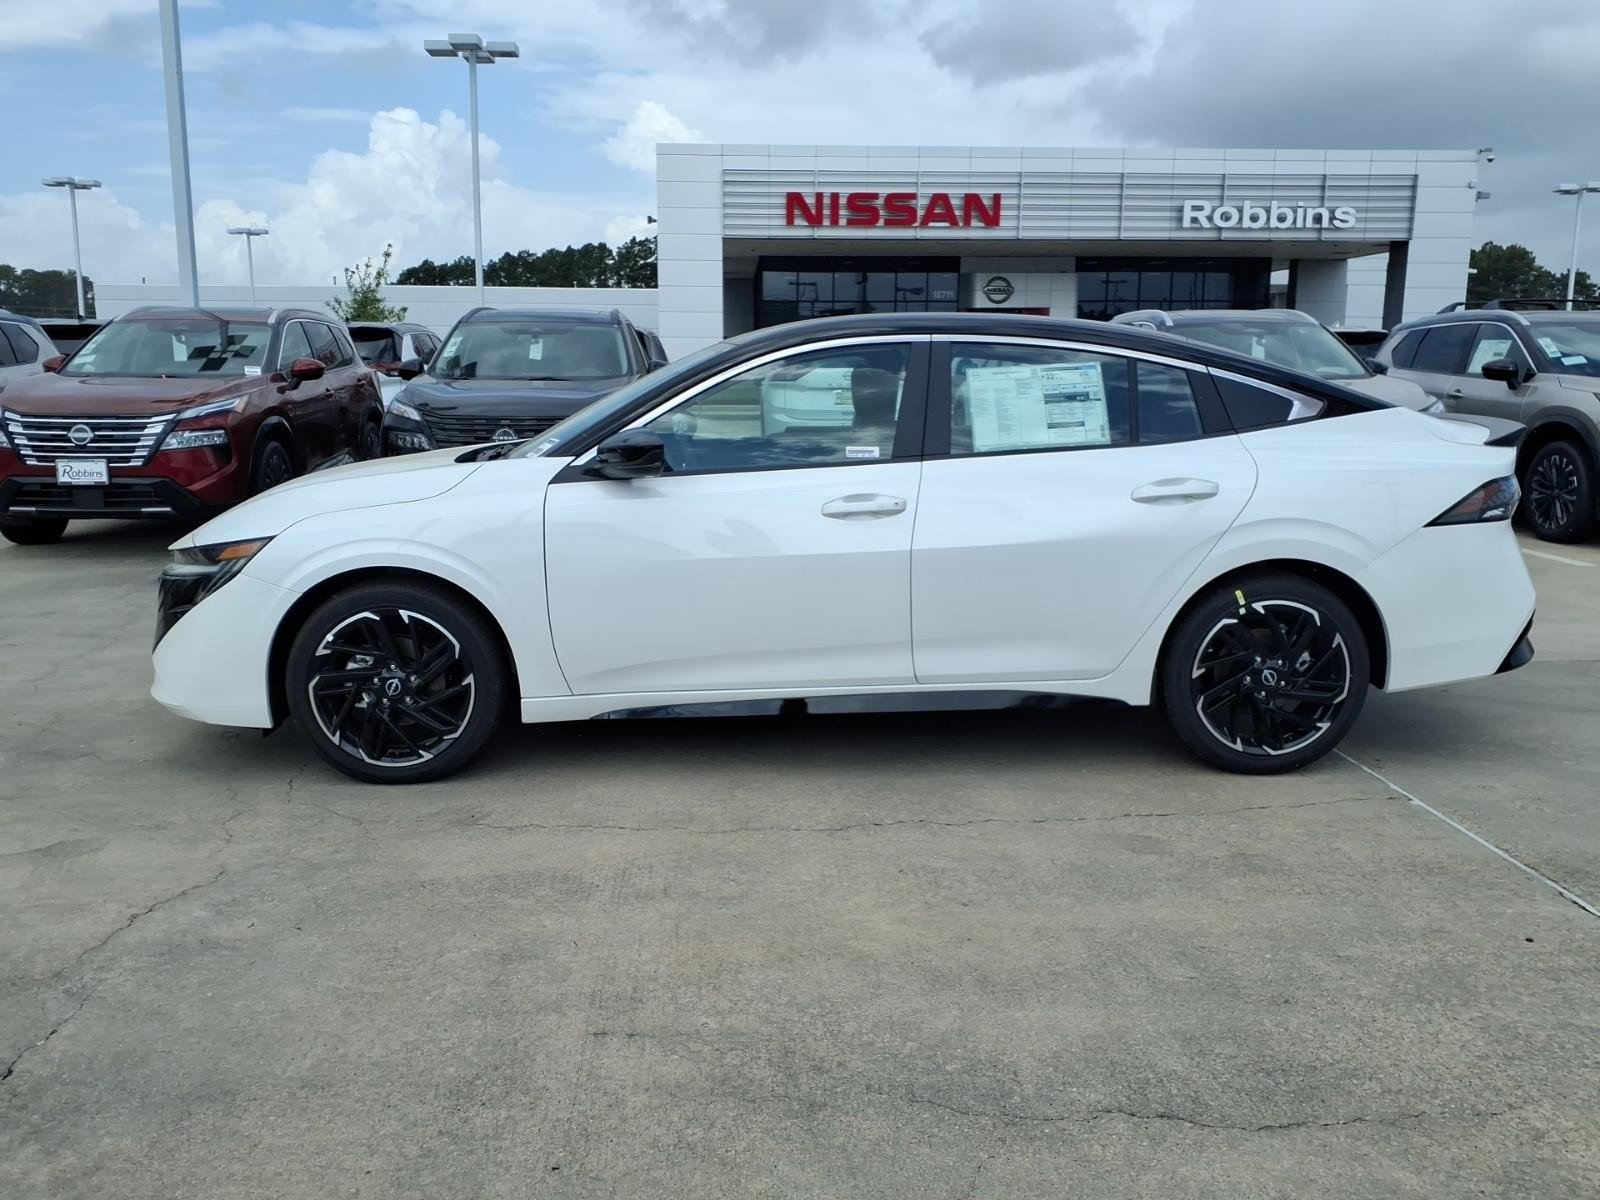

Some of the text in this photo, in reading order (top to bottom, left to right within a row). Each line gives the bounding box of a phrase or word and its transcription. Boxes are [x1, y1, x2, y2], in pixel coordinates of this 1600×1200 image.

[786, 192, 1001, 228] NISSAN
[1182, 200, 1357, 229] Robbins
[61, 464, 104, 480] Robbins
